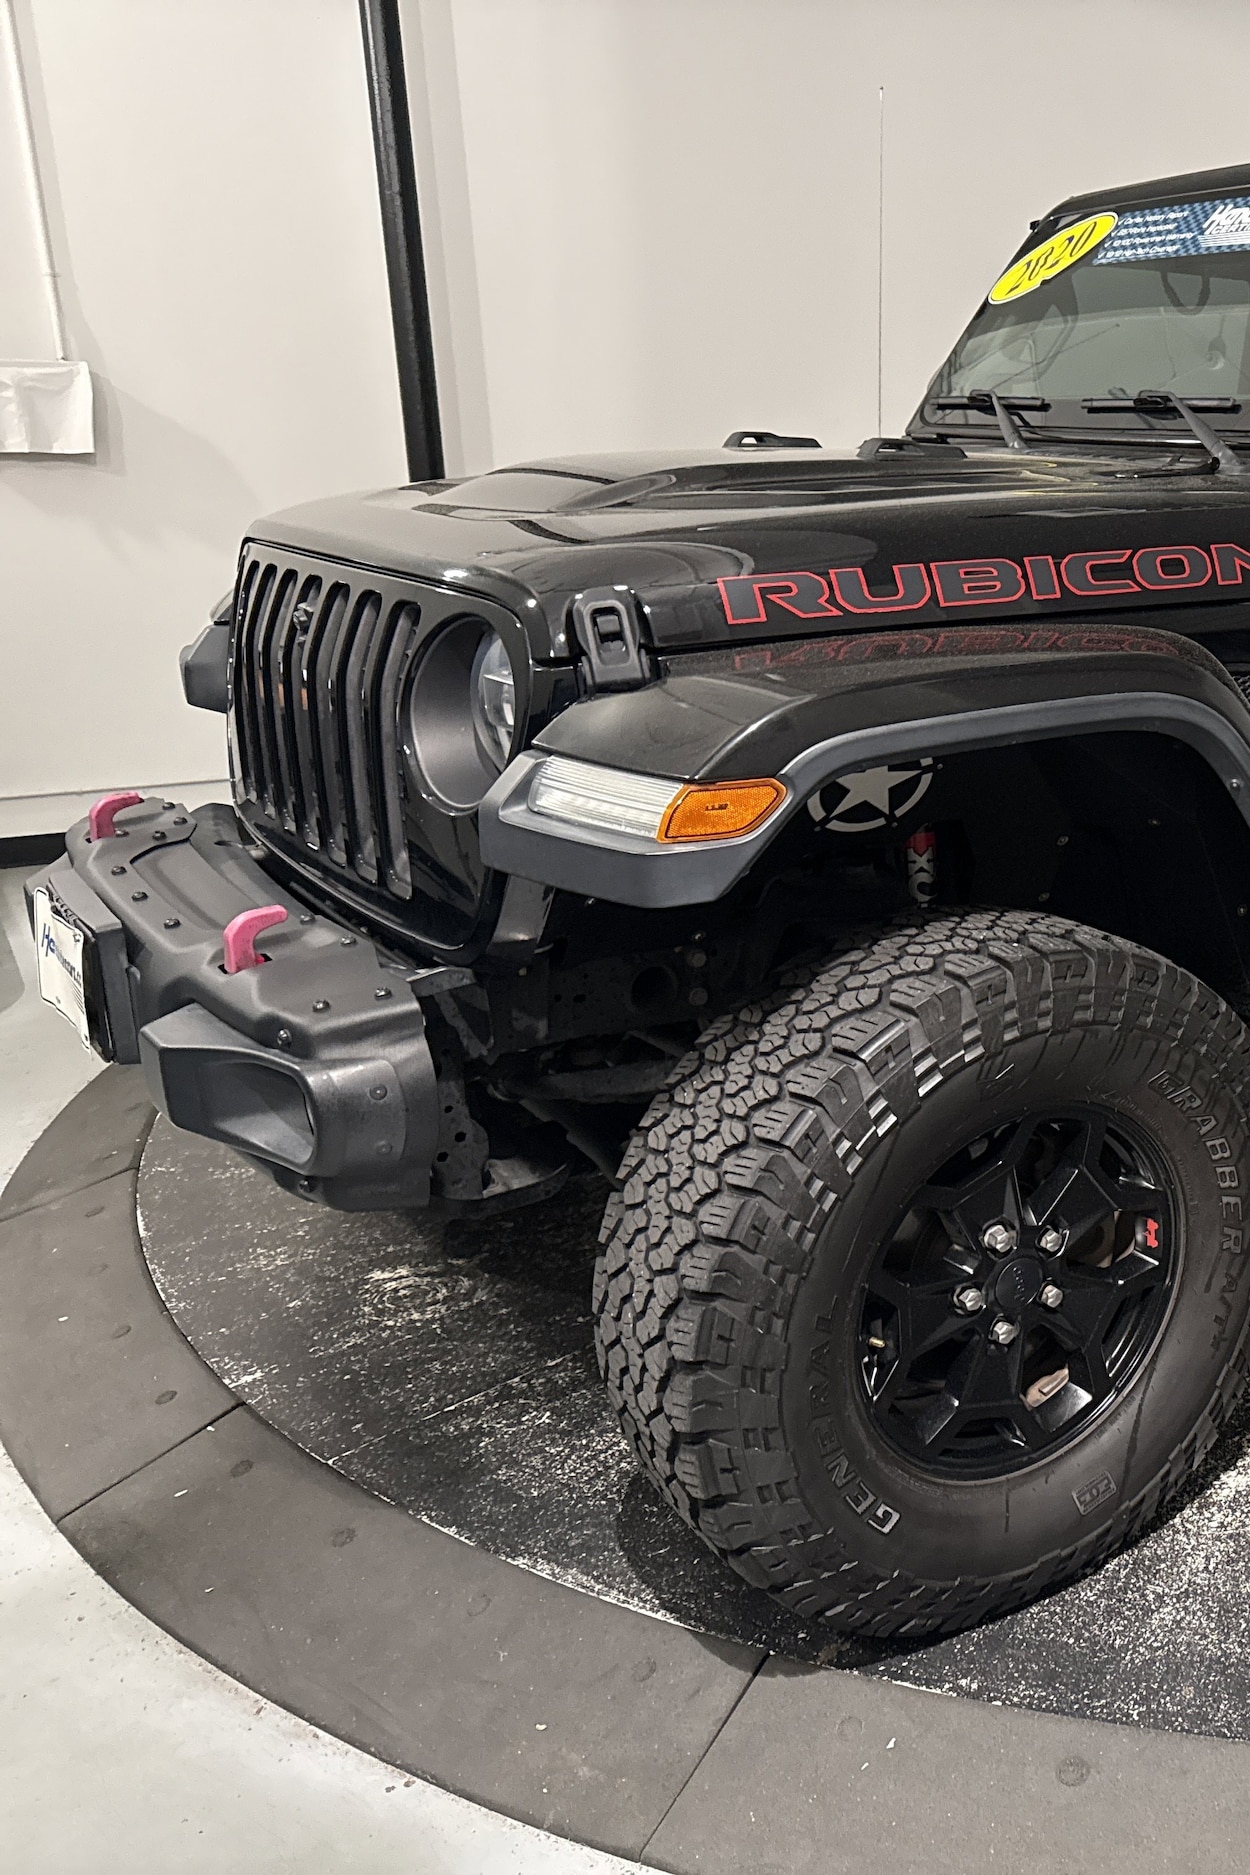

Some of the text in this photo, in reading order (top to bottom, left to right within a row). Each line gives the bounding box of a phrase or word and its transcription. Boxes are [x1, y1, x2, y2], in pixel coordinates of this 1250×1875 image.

[1005, 221, 1097, 297] 2020
[1147, 1069, 1244, 1254] GRABBER
[806, 1294, 901, 1534] GENERAL
